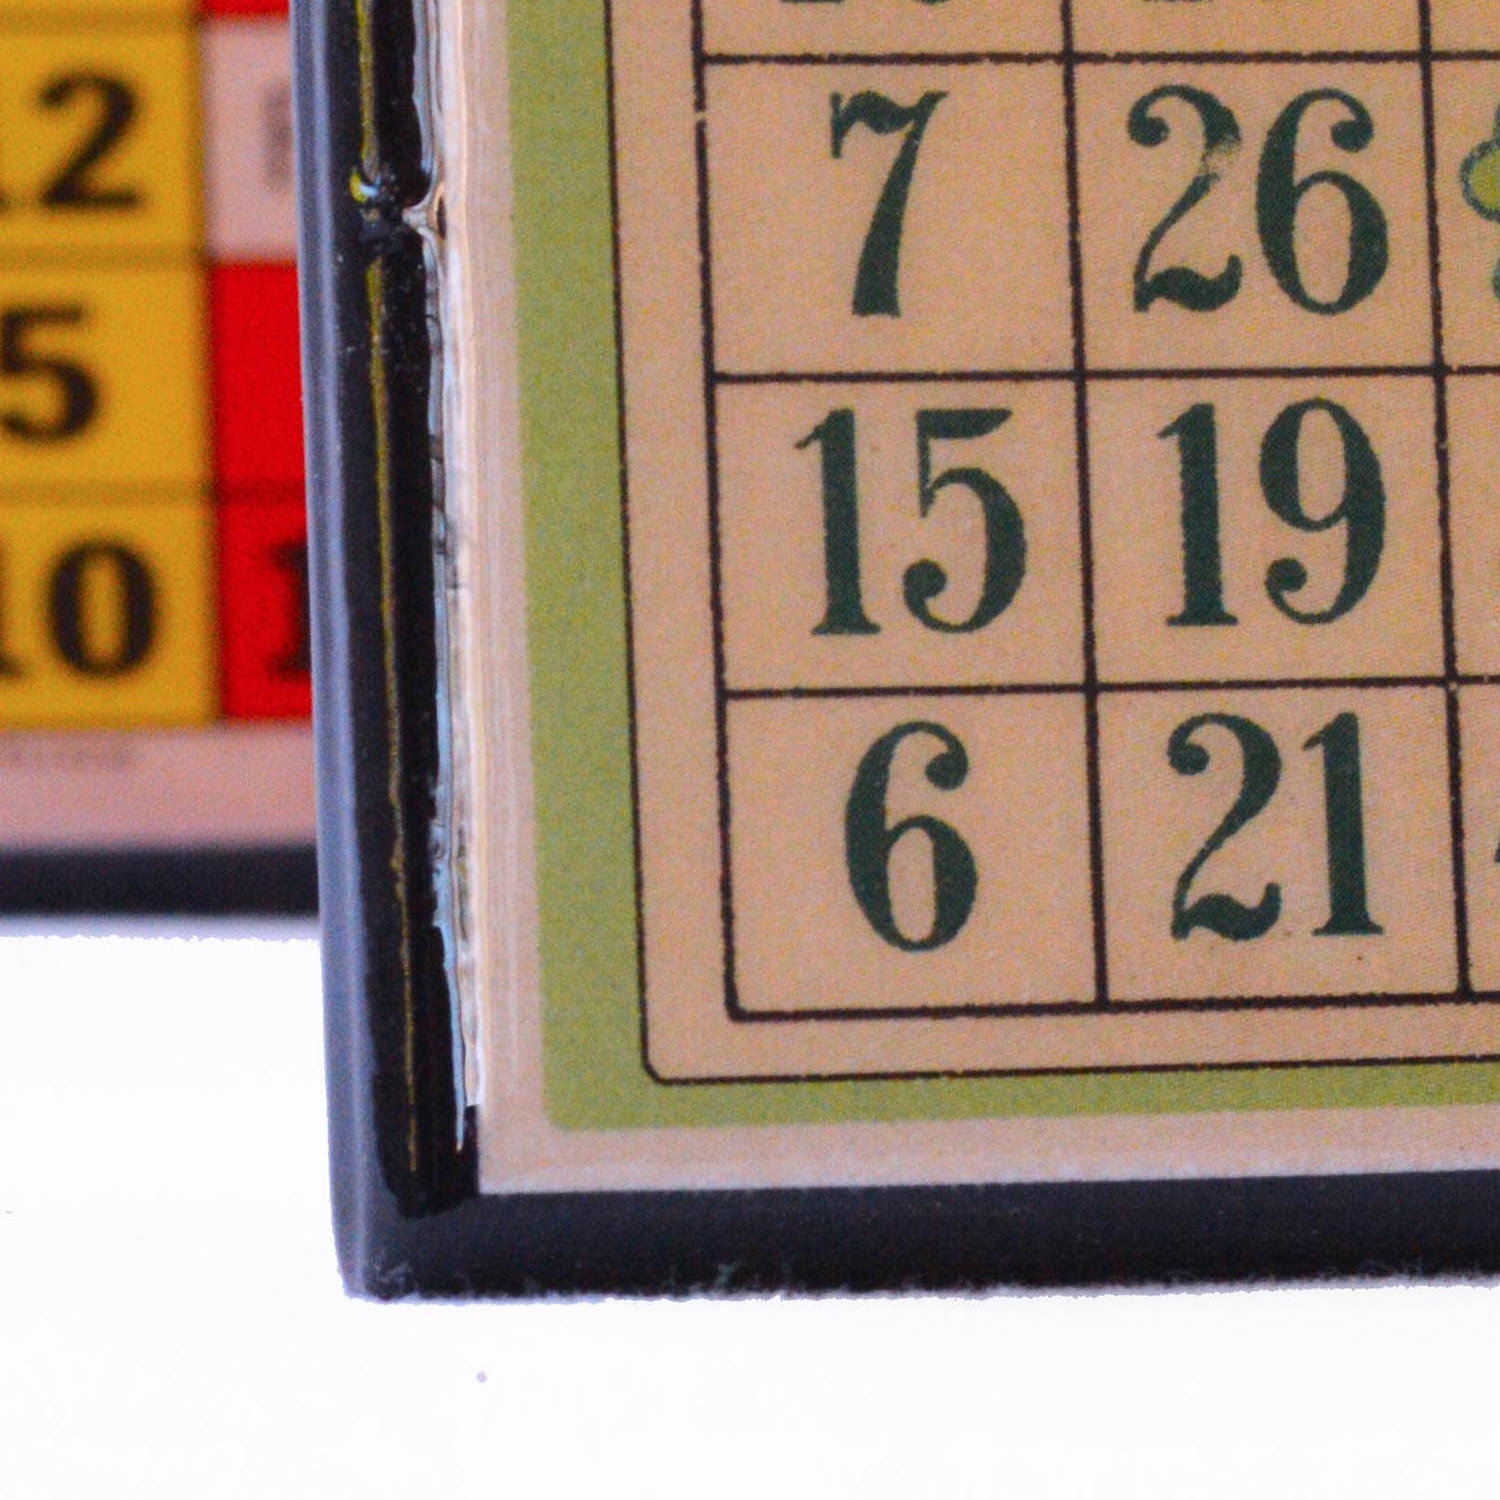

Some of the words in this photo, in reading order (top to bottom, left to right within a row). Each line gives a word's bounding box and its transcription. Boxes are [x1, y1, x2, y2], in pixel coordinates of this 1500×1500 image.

[831, 91, 946, 316] 7
[1128, 85, 1389, 315] 26
[798, 408, 1027, 635] 15
[1160, 398, 1386, 627] 19
[845, 721, 978, 952] 6
[1167, 712, 1383, 942] 21
